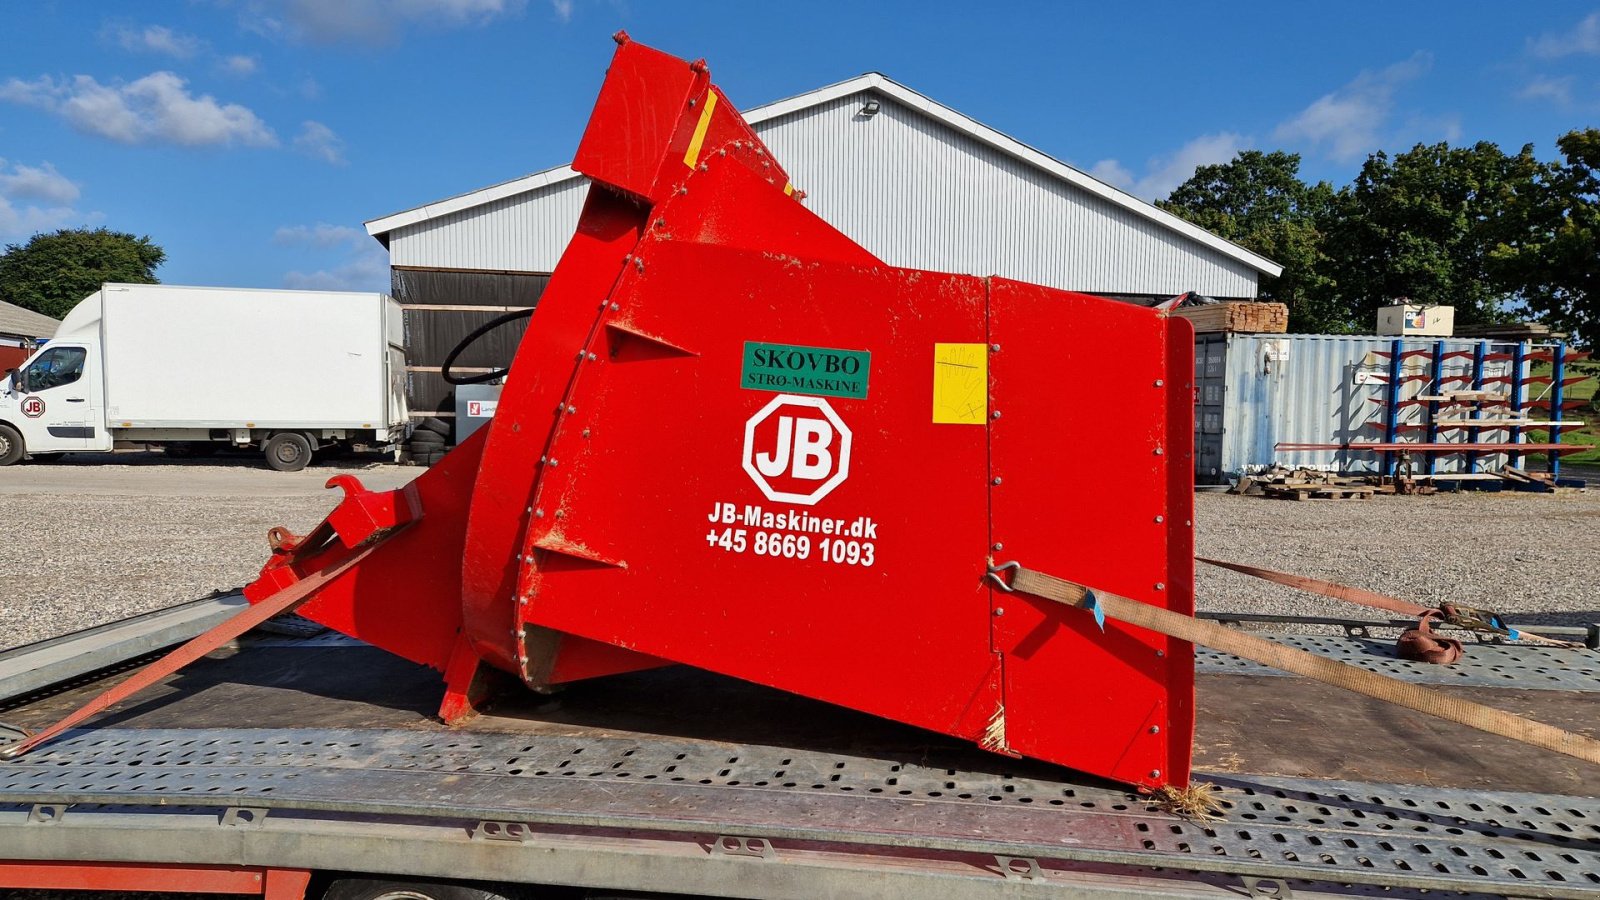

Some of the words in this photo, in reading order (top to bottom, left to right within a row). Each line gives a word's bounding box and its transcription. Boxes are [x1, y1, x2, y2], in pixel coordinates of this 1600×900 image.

[752, 348, 860, 375] SKOVBO
[748, 372, 861, 393] STRØ-MASKINE
[26, 402, 41, 412] JB
[755, 416, 833, 480] JB
[708, 502, 878, 539] JB-Maskiner.dk
[706, 528, 747, 553] +45
[753, 531, 811, 559] 8669
[819, 538, 875, 567] 1093
